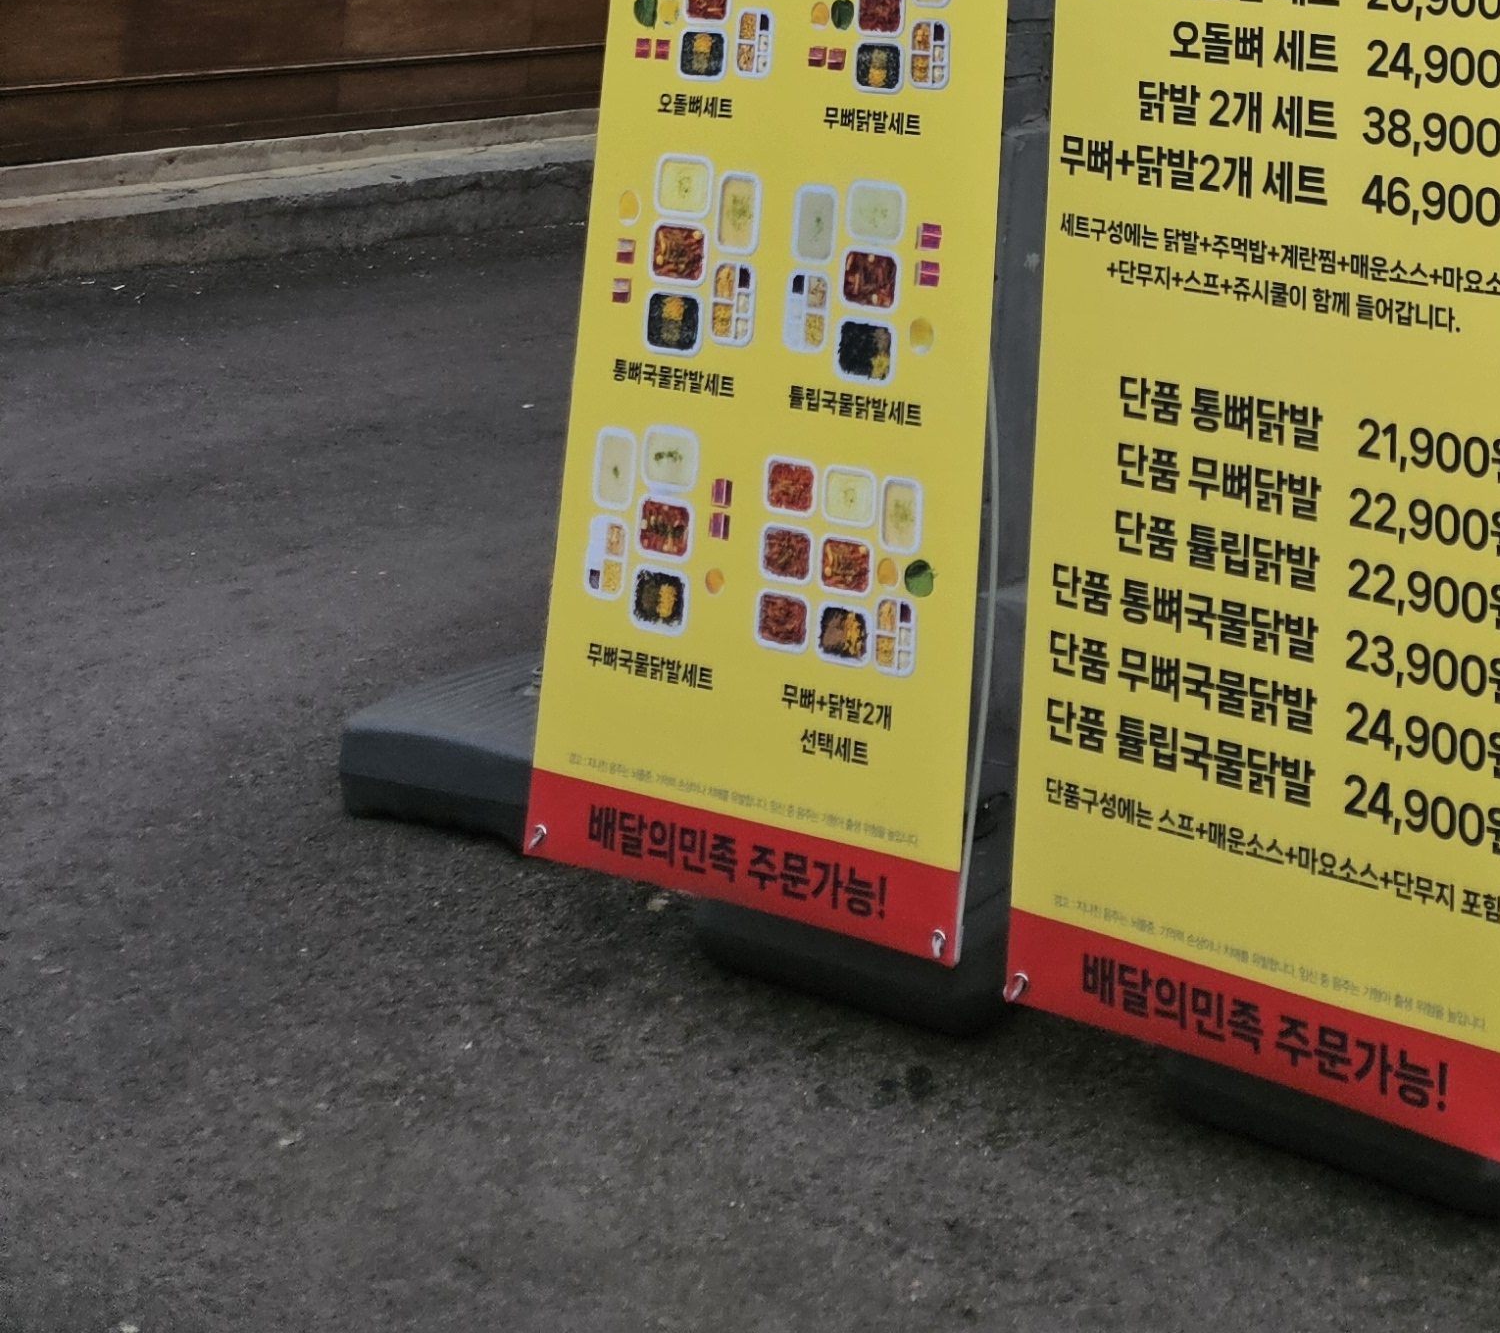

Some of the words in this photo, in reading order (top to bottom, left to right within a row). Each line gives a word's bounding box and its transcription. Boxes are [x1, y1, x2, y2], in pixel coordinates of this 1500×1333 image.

[1170, 21, 1263, 67] 오돌뼈
[1274, 30, 1338, 72] 세트
[658, 94, 732, 118] 오돌뼈세트
[824, 107, 920, 135] 무뼈닭발세트
[1139, 81, 1200, 126] 닭발
[1210, 90, 1262, 133] 2개
[1272, 96, 1337, 139] 세트
[1262, 161, 1327, 205] 세트
[1061, 213, 1159, 249] 세트구성에는
[1313, 288, 1350, 317] 함께
[1356, 294, 1460, 332] 들어갑니다.
[613, 359, 734, 397] 통뼈국물닭발세트
[789, 385, 921, 426] 튤립국물닭발세트
[1120, 376, 1182, 426] 단품
[1191, 387, 1323, 451] 통뼈닭발
[1118, 443, 1180, 493] 단품
[1189, 456, 1321, 521] 무뼈닭발
[1116, 510, 1177, 562] 단품
[1186, 523, 1320, 593] 튤립닭발
[1053, 563, 1112, 616] 단품
[1120, 578, 1319, 663] 통뼈국물닭발
[587, 643, 712, 690] 무뼈국물닭발세트
[782, 684, 891, 730] 무뼈+닭발2개
[1050, 630, 1109, 684] 단품
[1118, 647, 1317, 735] 무뼈국물닭발
[801, 729, 867, 765] 선택세트
[1047, 698, 1107, 753] 단품
[1116, 715, 1315, 807] 튤립국물닭발
[1046, 778, 1153, 829] 단품구성에는
[588, 802, 738, 884] 배달의민족
[747, 843, 889, 920] 주문가능!
[1081, 952, 1264, 1054] 배달의민족
[1275, 1014, 1449, 1111] 주문가능!
